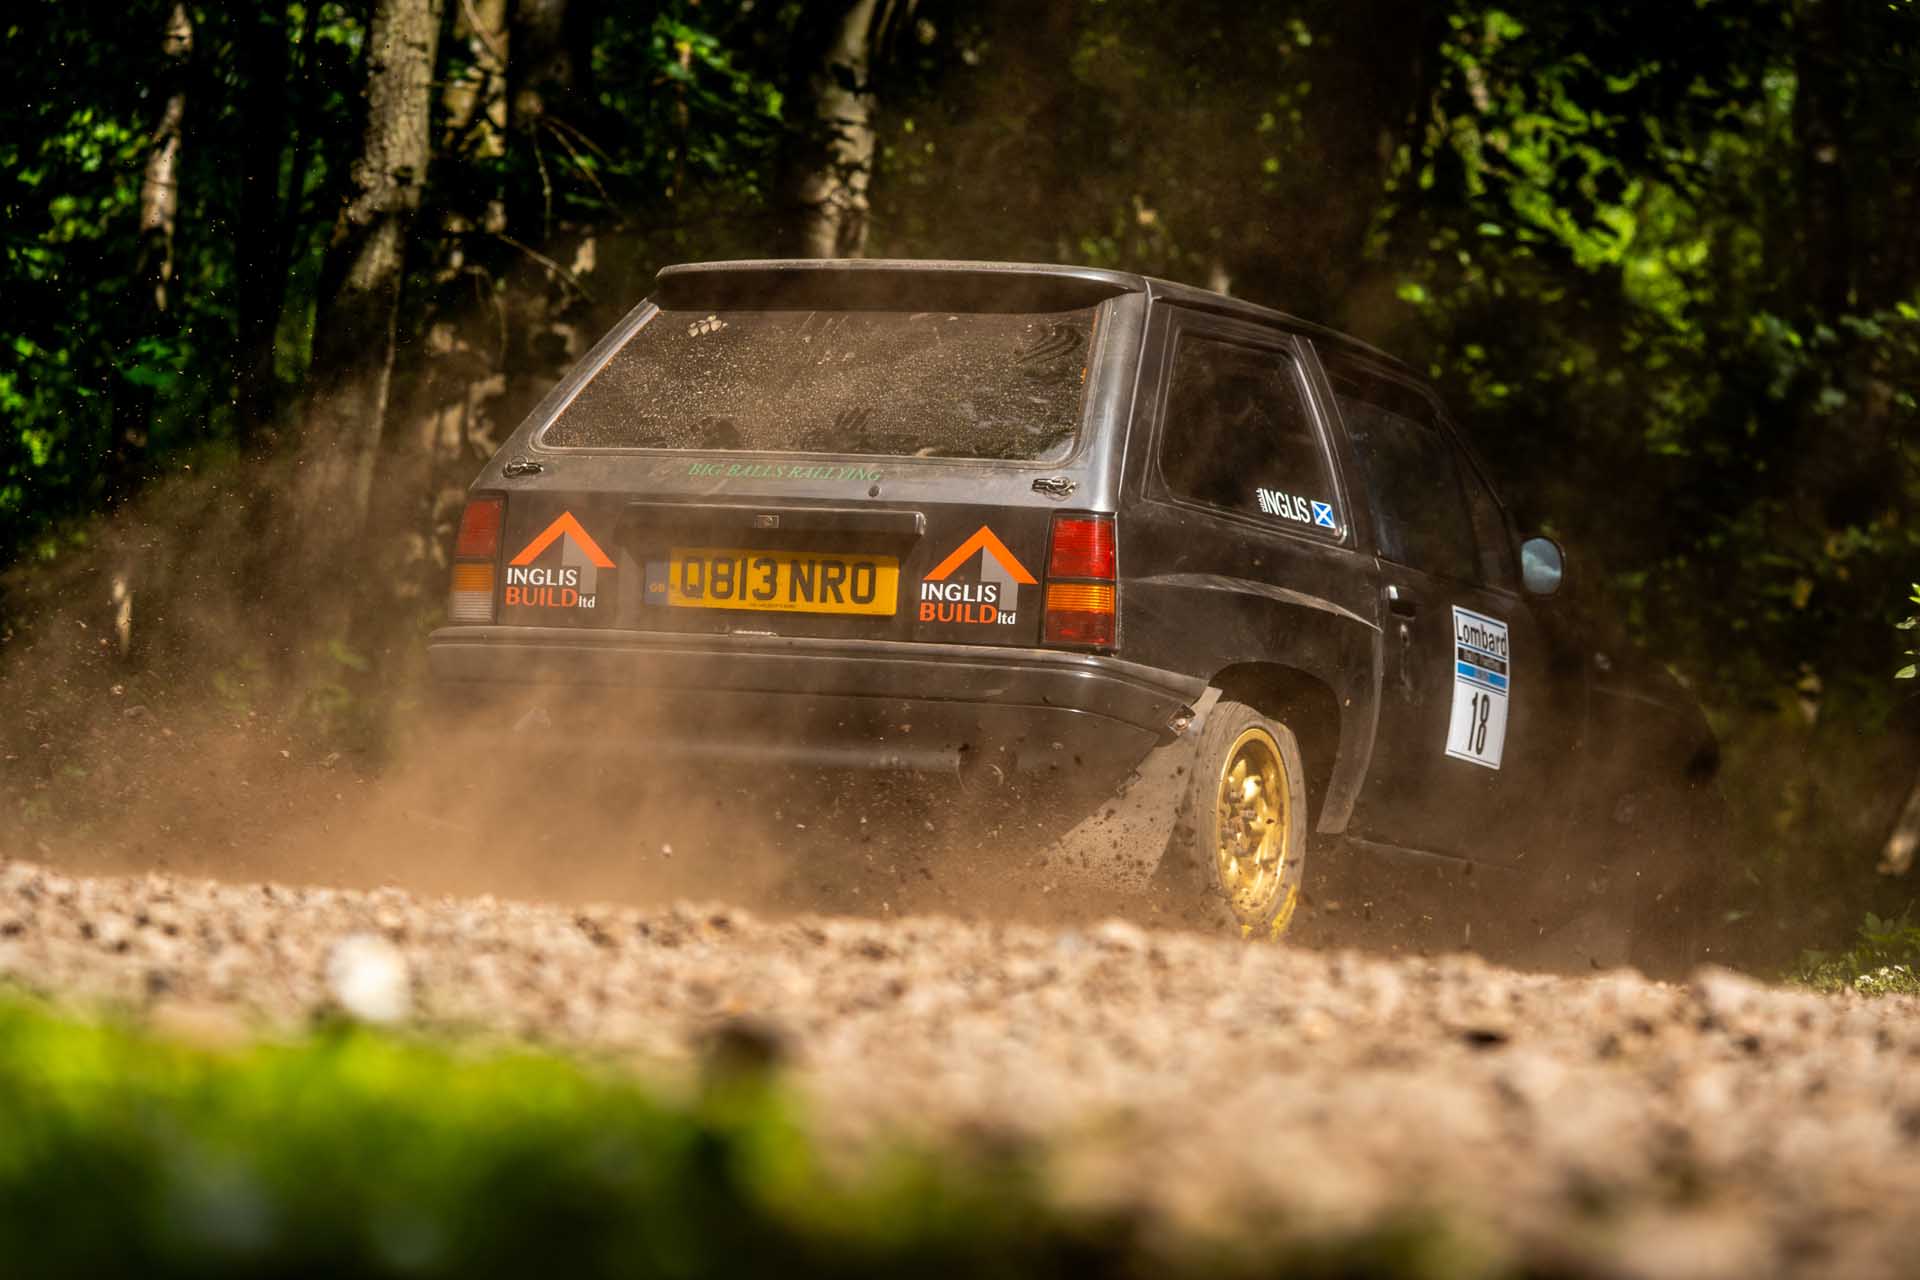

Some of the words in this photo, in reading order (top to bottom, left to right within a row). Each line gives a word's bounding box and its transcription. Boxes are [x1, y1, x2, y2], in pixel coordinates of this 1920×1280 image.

[688, 463, 723, 476] BIG
[788, 465, 881, 481] RALLYING
[1259, 488, 1311, 523] INGLIS
[506, 567, 577, 586] INGLIS
[680, 556, 778, 601] Q813
[789, 559, 877, 604] NRO
[505, 586, 577, 608] BUILD
[578, 595, 596, 608] ltd
[921, 583, 997, 602] INGLIS
[919, 602, 997, 624] BUILD
[997, 611, 1016, 625] ltd
[1456, 615, 1507, 656] Lombard
[1468, 691, 1490, 755] 18
